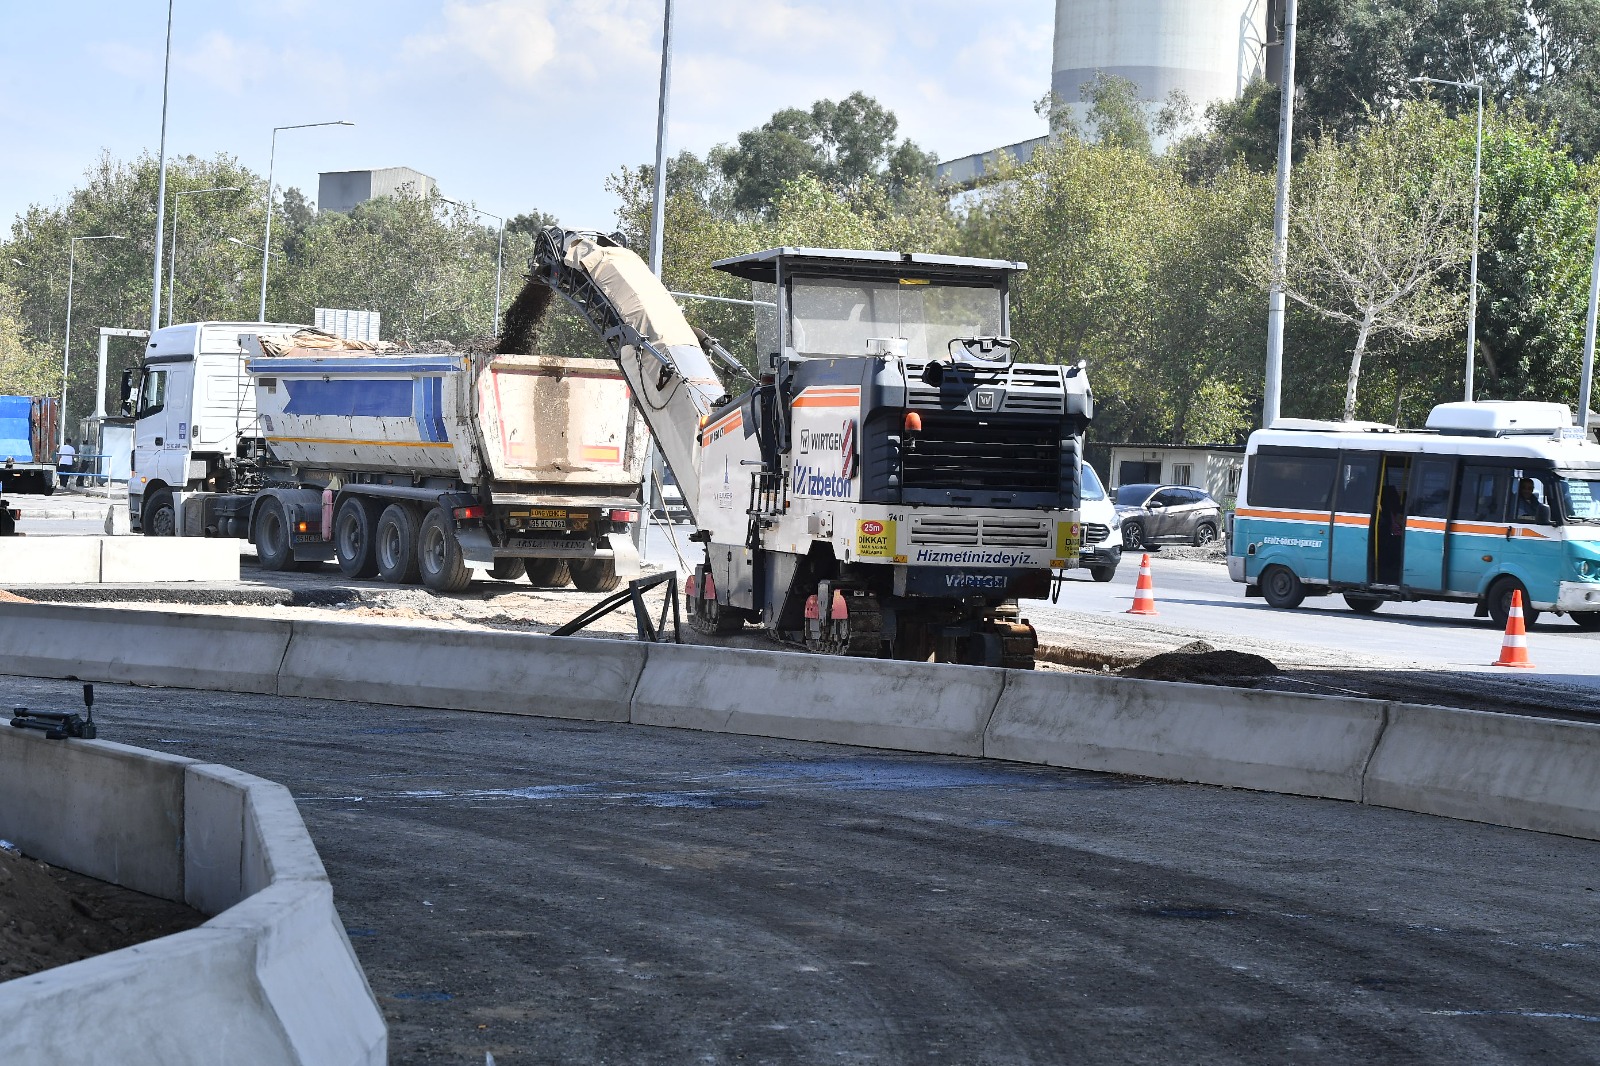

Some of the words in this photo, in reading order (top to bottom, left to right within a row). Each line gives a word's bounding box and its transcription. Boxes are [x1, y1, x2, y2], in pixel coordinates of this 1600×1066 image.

[808, 466, 852, 498] izbeton
[864, 524, 880, 532] 25m
[859, 535, 888, 544] DİKKAT
[916, 549, 1038, 567] Hizmetinizdeyiz..
